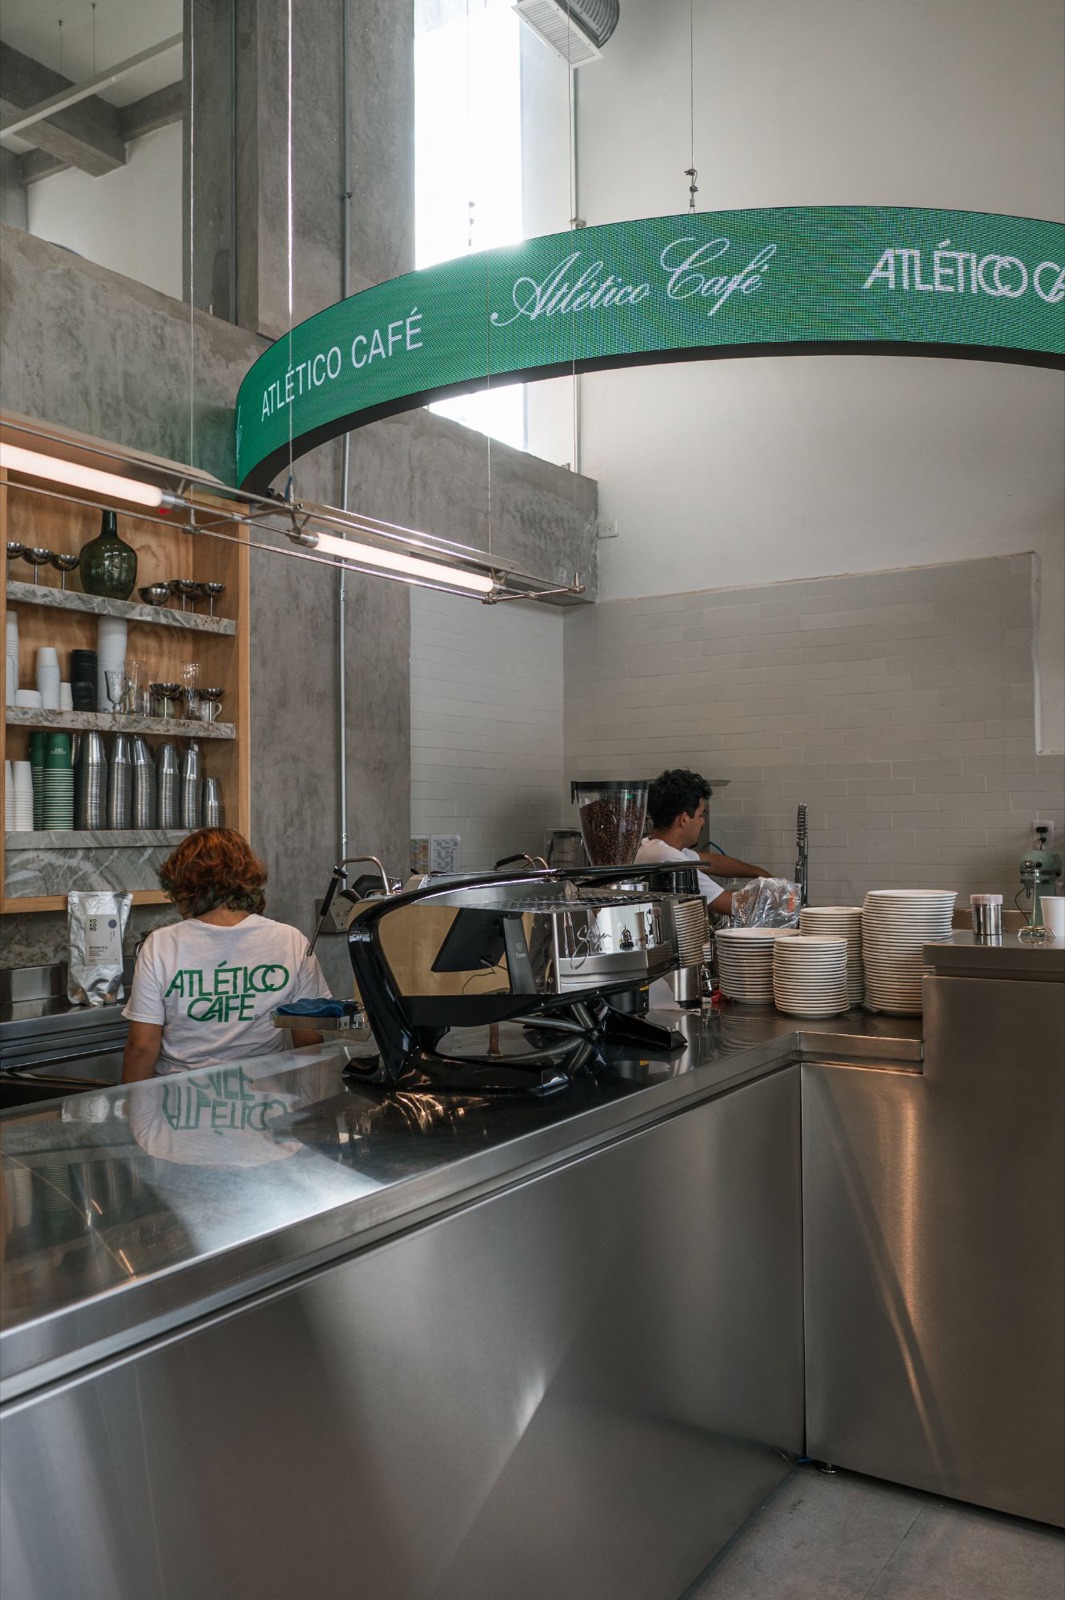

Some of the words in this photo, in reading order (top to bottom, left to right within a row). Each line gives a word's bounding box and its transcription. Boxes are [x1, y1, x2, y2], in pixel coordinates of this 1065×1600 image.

[490, 251, 650, 327] Atlético
[660, 237, 777, 316] Café
[863, 239, 1028, 298] ATLÉTICO
[261, 346, 342, 422] ATLÉTICO
[351, 306, 424, 369] CAFÉ
[164, 960, 290, 998] ATLÉTICO
